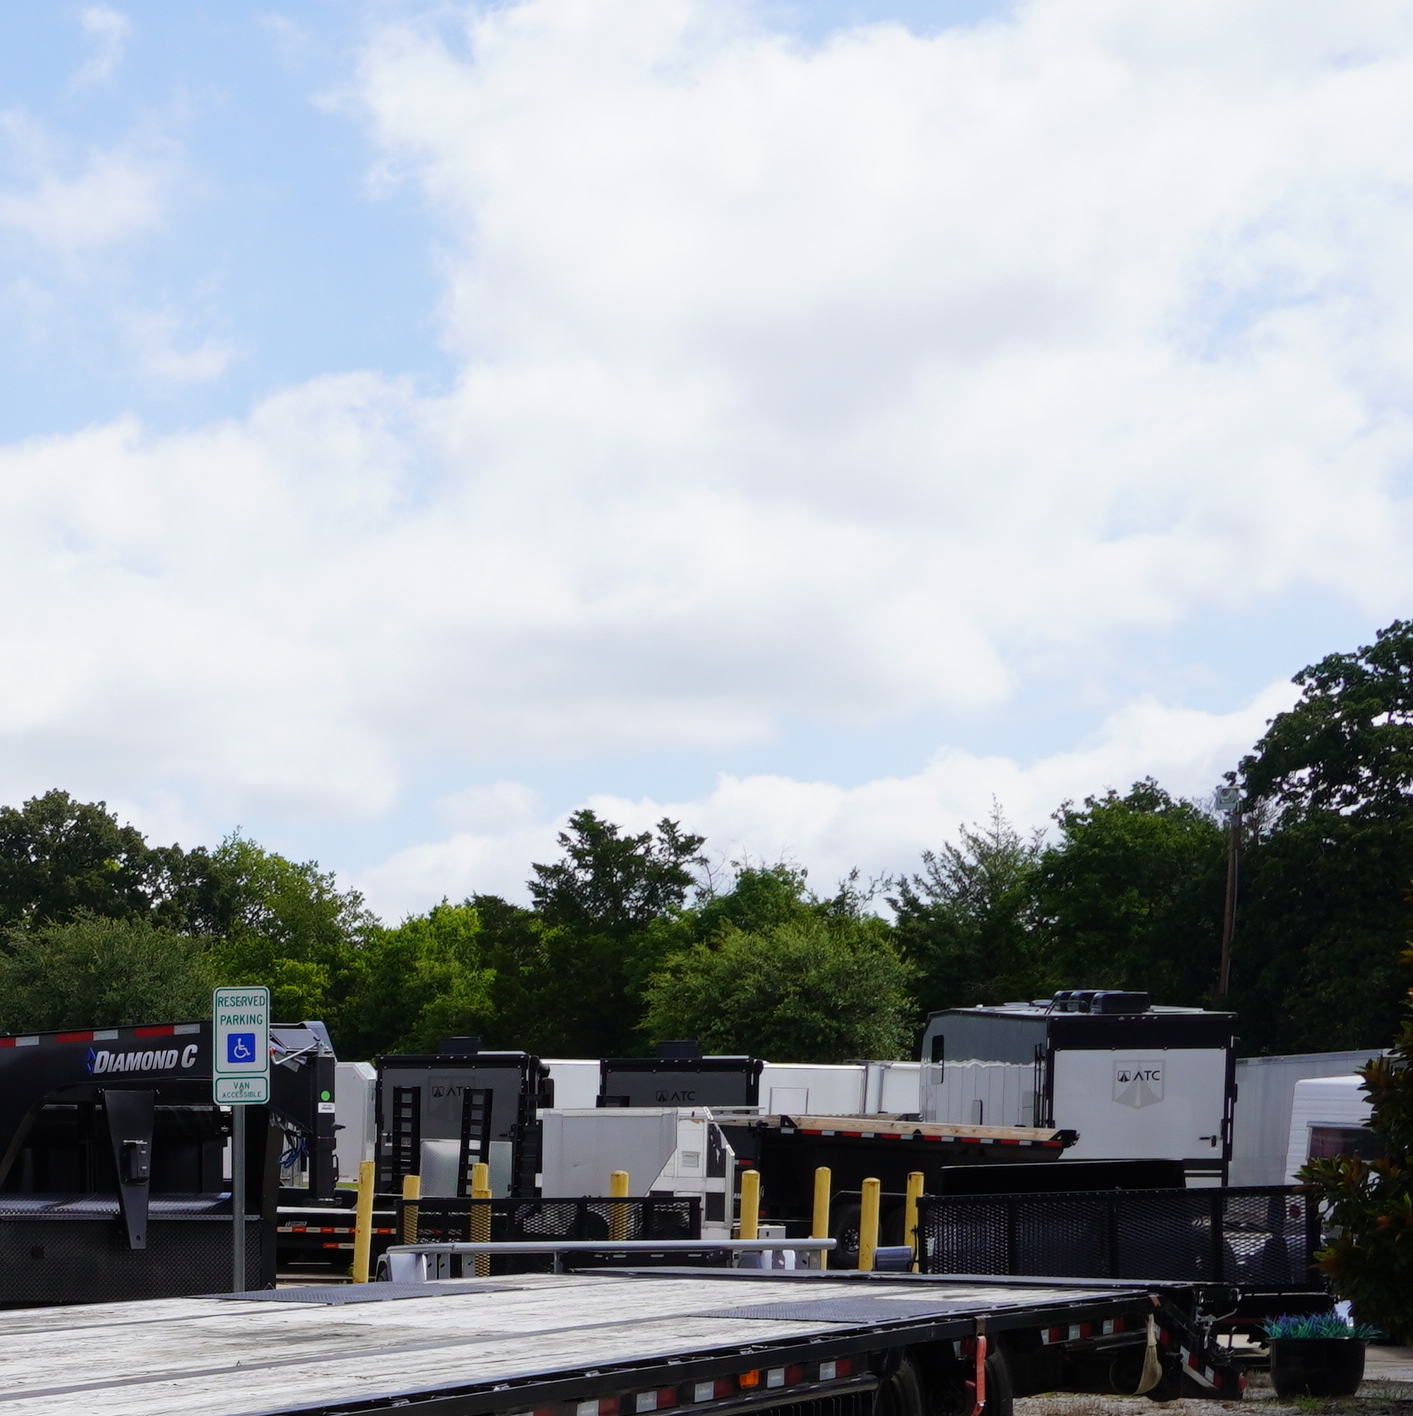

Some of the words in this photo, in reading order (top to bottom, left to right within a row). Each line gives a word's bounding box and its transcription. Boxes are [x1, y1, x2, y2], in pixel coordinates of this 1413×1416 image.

[217, 995, 266, 1008] RESERVED
[220, 1014, 263, 1026] PARKING
[93, 1049, 178, 1074] DIAMOND
[180, 1044, 199, 1069] C
[1133, 1070, 1161, 1081] ATC
[233, 1081, 250, 1090] VAN
[221, 1090, 262, 1099] ACCESSIBLE
[671, 1090, 696, 1102] ATC
